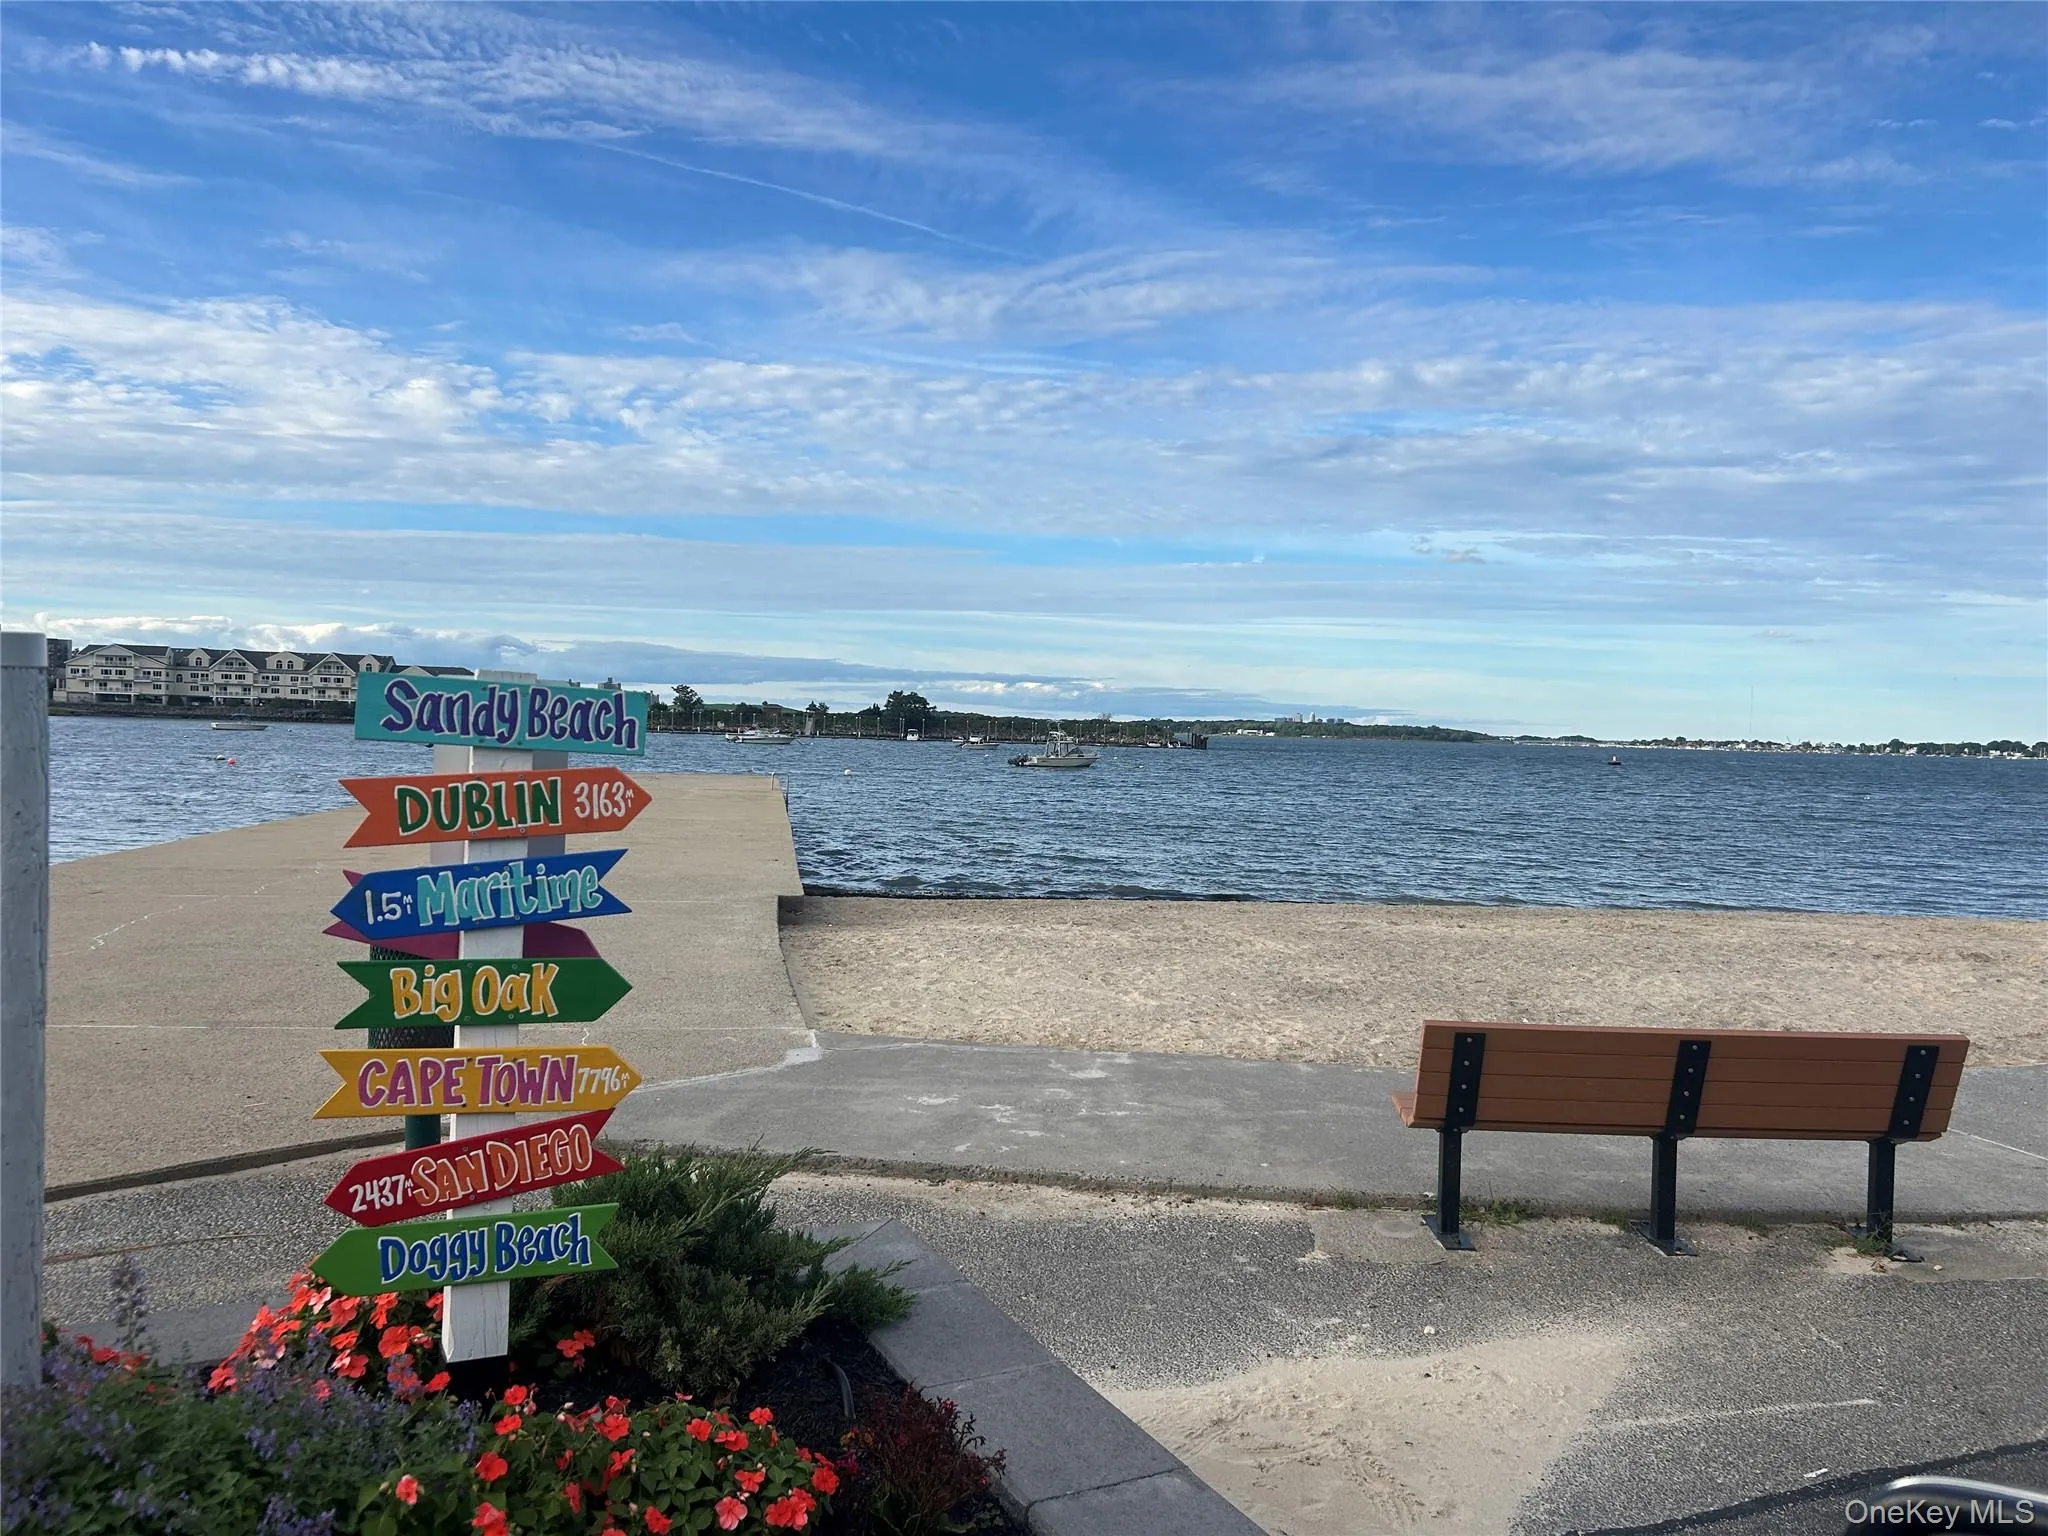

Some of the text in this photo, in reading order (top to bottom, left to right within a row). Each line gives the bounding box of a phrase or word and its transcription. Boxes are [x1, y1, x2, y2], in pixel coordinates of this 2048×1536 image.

[380, 678, 640, 750] Sandy Beach
[394, 777, 562, 837] DUBLIN
[573, 780, 626, 820] 3163
[364, 889, 402, 925] 1.5
[416, 861, 604, 927] Maritime
[390, 964, 462, 1023] Big
[358, 1057, 466, 1109] CAPE
[475, 1055, 578, 1107] TOWN
[349, 1174, 405, 1214] 2437
[411, 1149, 489, 1207] SAN
[486, 1123, 593, 1191] DIEGO
[377, 1212, 593, 1286] Doggy Beach
